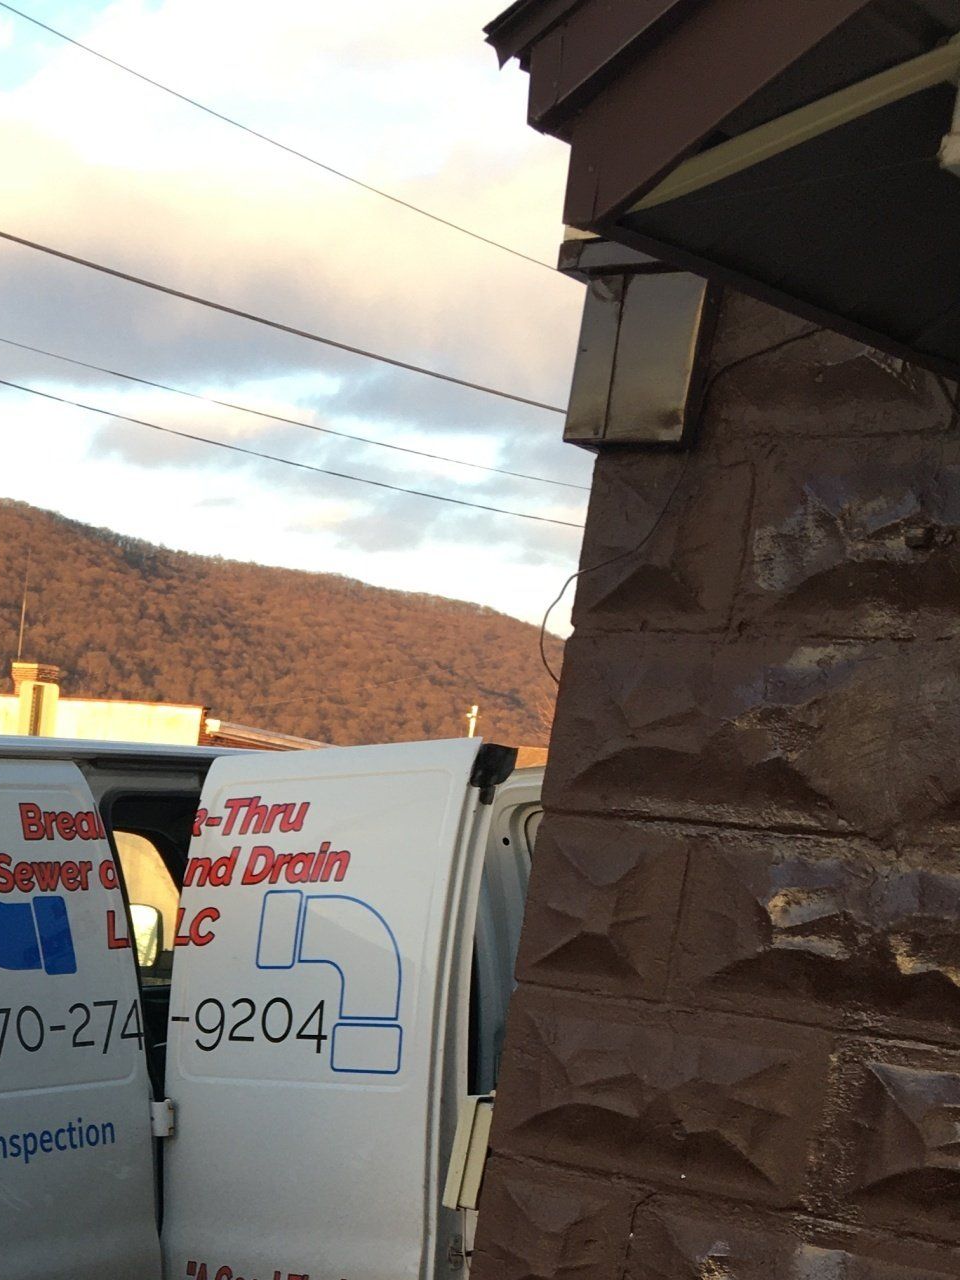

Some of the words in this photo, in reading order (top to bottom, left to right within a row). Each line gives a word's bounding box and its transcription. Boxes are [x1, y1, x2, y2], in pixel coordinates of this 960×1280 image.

[183, 846, 241, 887] nd
[241, 841, 351, 886] Drain
[171, 997, 328, 1054] -9204
